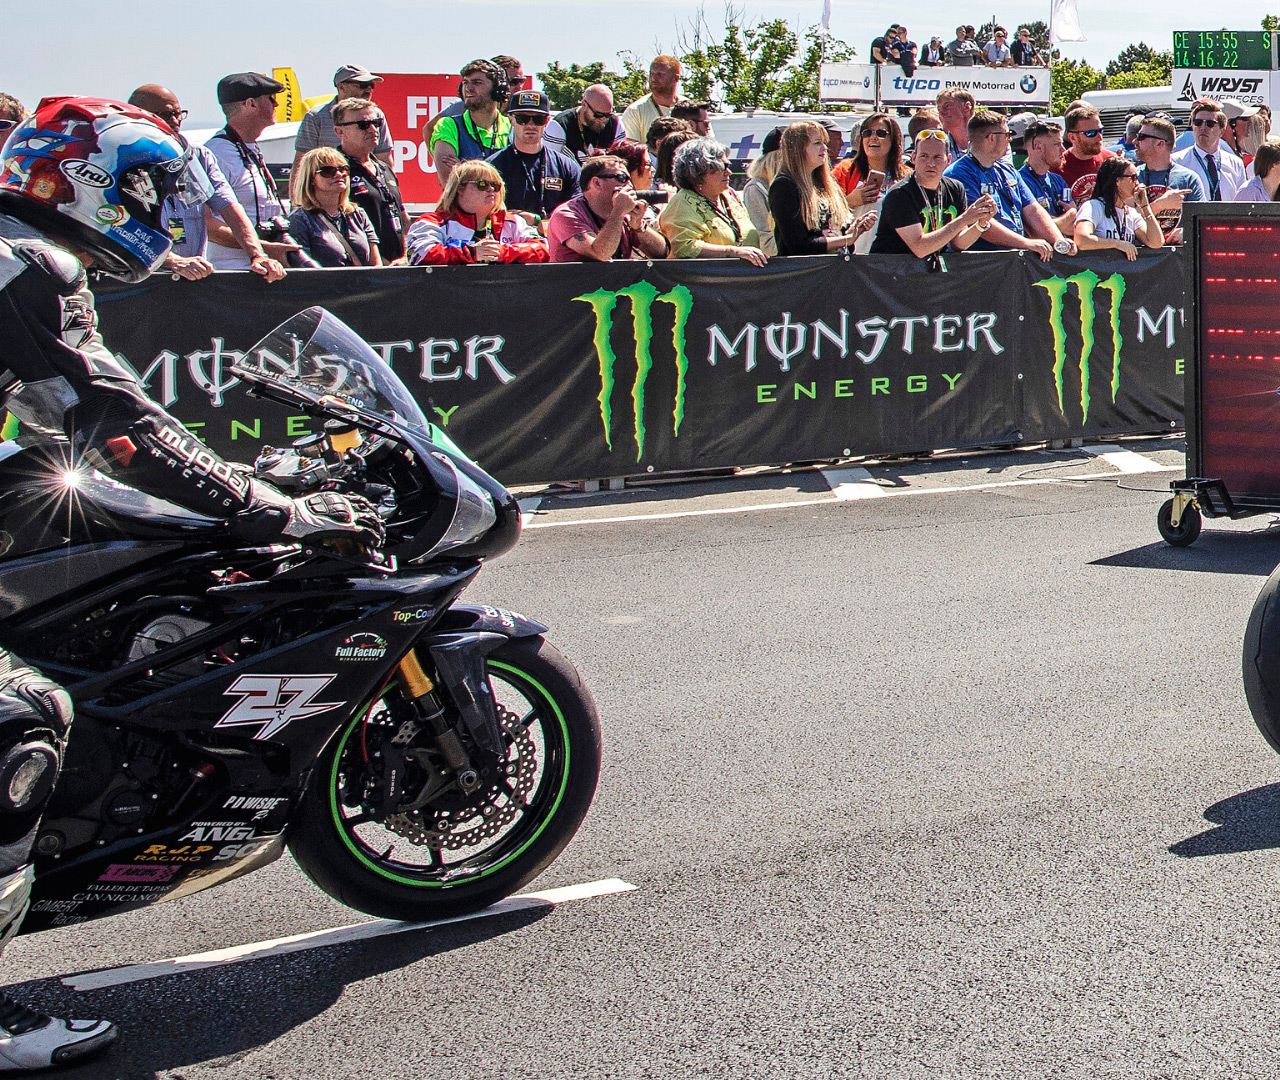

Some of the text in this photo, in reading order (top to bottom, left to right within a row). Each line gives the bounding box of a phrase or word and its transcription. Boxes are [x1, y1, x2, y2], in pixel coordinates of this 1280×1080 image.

[1174, 32, 1190, 49] CE
[1198, 32, 1239, 49] 15:55
[1175, 51, 1239, 68] 14:16:22
[823, 78, 839, 90] tyco
[893, 76, 1016, 94] tyco BMW Motorrad
[1201, 77, 1264, 93] WRYST
[71, 161, 109, 185] Arai
[706, 308, 1006, 373] MONSTER
[115, 335, 516, 409] MONSTER
[756, 372, 964, 404] ENERGY
[187, 405, 460, 443] ENEY
[158, 425, 246, 503] mygdal
[150, 447, 233, 508] RACING
[335, 646, 387, 658] Full Factory
[213, 672, 348, 741] 27
[134, 854, 203, 863] RACING
[143, 844, 215, 856] R.J.P
[87, 883, 126, 893] TALLER
[125, 884, 140, 893] DE
[72, 892, 111, 902] CAN
[31, 899, 84, 913] GIMBERT
